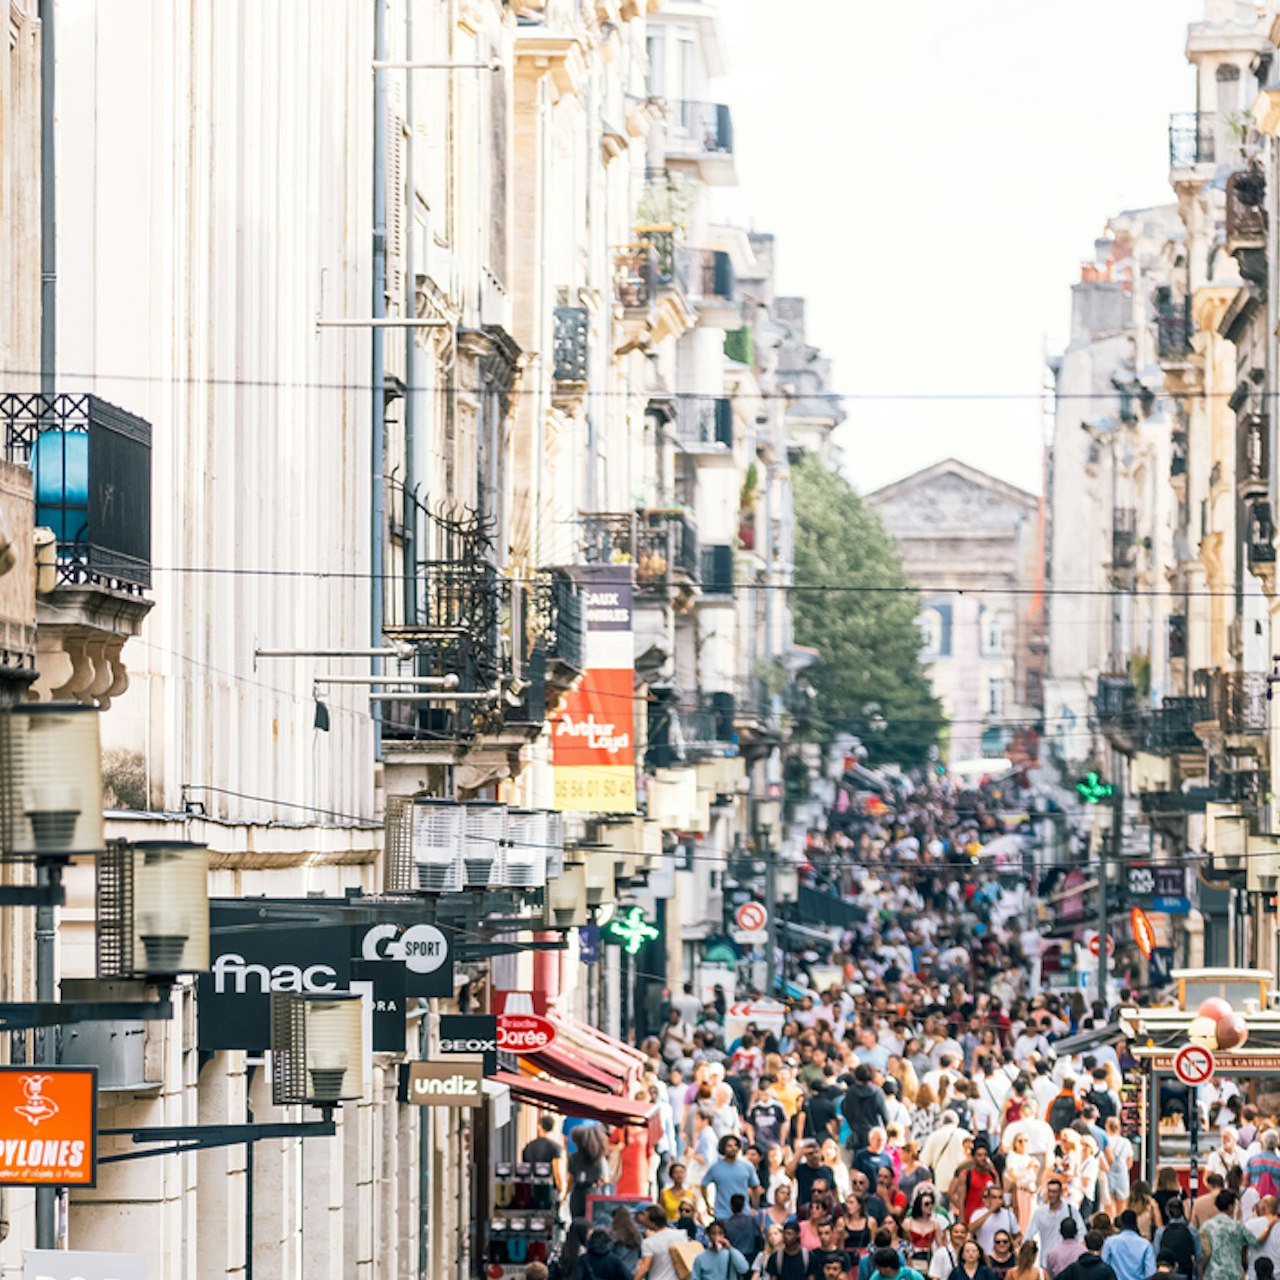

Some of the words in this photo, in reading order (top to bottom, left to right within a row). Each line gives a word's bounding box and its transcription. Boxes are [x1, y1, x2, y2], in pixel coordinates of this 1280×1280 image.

[556, 713, 615, 737] Arthur
[405, 940, 441, 957] SPORT
[212, 953, 337, 993] fnac
[440, 1039, 496, 1052] GEOX
[414, 1074, 478, 1096] undiz
